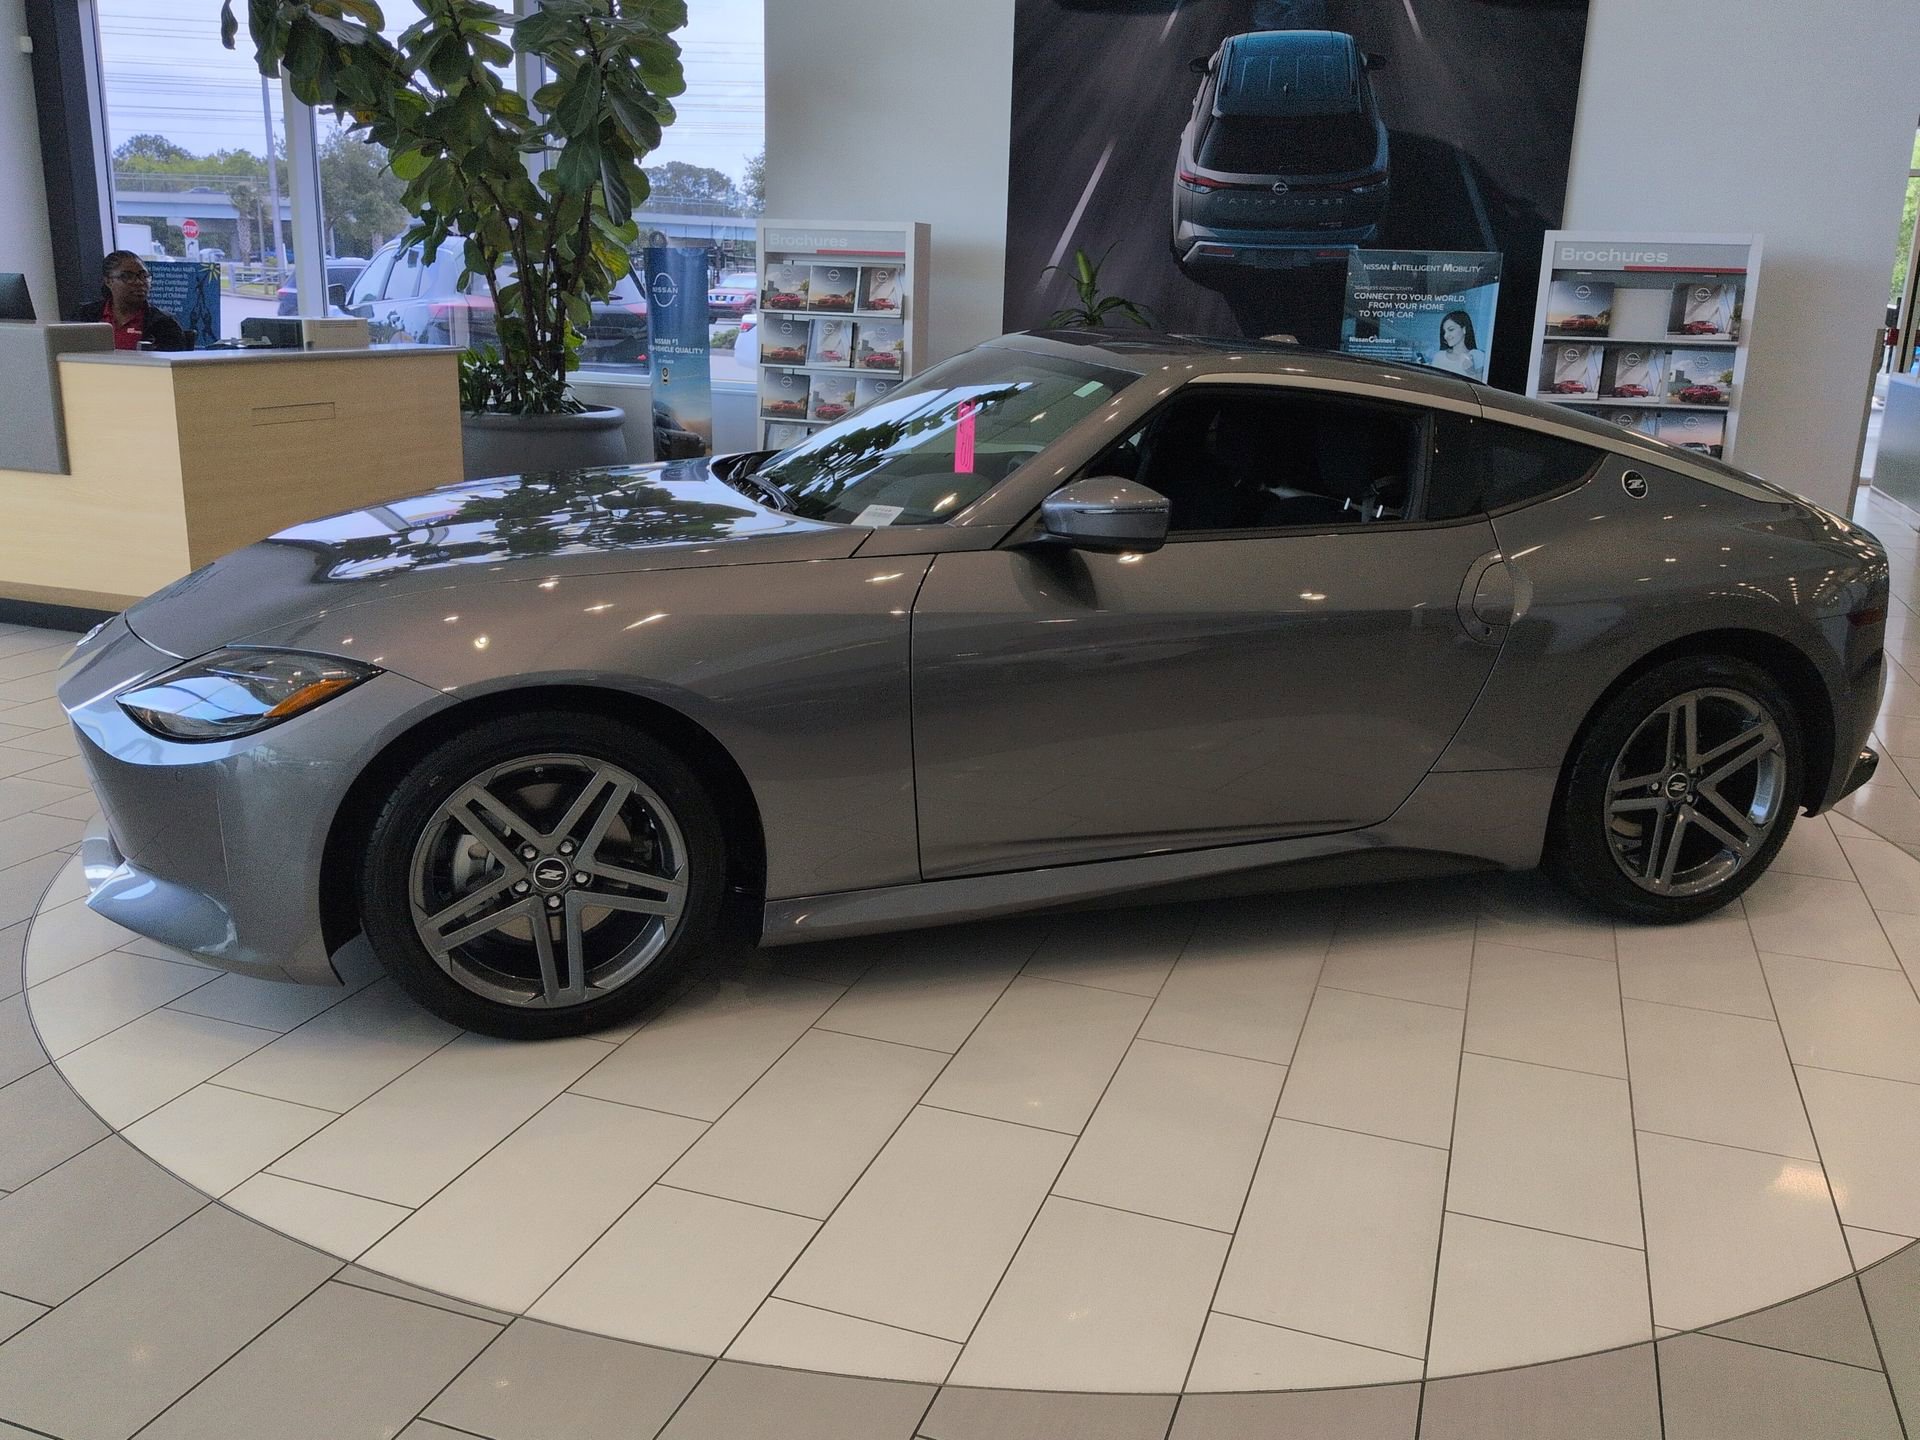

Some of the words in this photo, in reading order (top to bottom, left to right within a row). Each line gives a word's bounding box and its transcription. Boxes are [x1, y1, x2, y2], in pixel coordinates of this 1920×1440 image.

[183, 225, 198, 233] STOP
[769, 233, 848, 247] Brochures
[1561, 247, 1668, 263] Brochures
[1363, 263, 1390, 271] NISSAN
[652, 286, 679, 294] NISSAN
[1354, 292, 1395, 300] CONNECT
[1396, 293, 1408, 301] TO
[1409, 293, 1432, 302] YOUR
[1434, 294, 1466, 303] WORLD,
[1368, 301, 1393, 309] FROM
[1394, 302, 1417, 310] YOUR
[1419, 303, 1445, 311] HOME
[1372, 310, 1395, 318] YOUR
[1396, 311, 1415, 319] CAR
[675, 346, 704, 355] QUALITY
